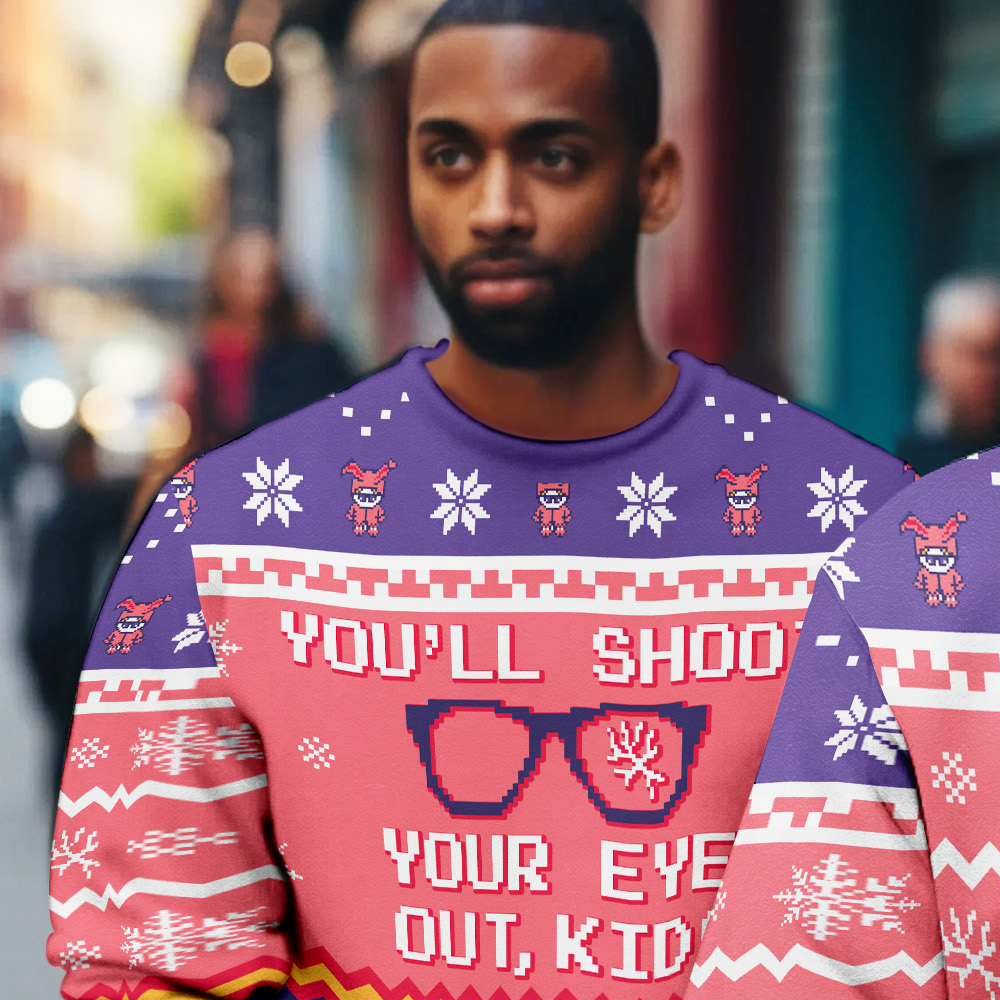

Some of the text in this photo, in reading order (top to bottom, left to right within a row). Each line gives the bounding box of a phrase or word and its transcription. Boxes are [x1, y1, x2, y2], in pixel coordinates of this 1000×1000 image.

[281, 611, 804, 688] YOU'LL SHOO
[383, 827, 738, 905] YOUR EYE
[395, 905, 711, 983] OUT, KID
